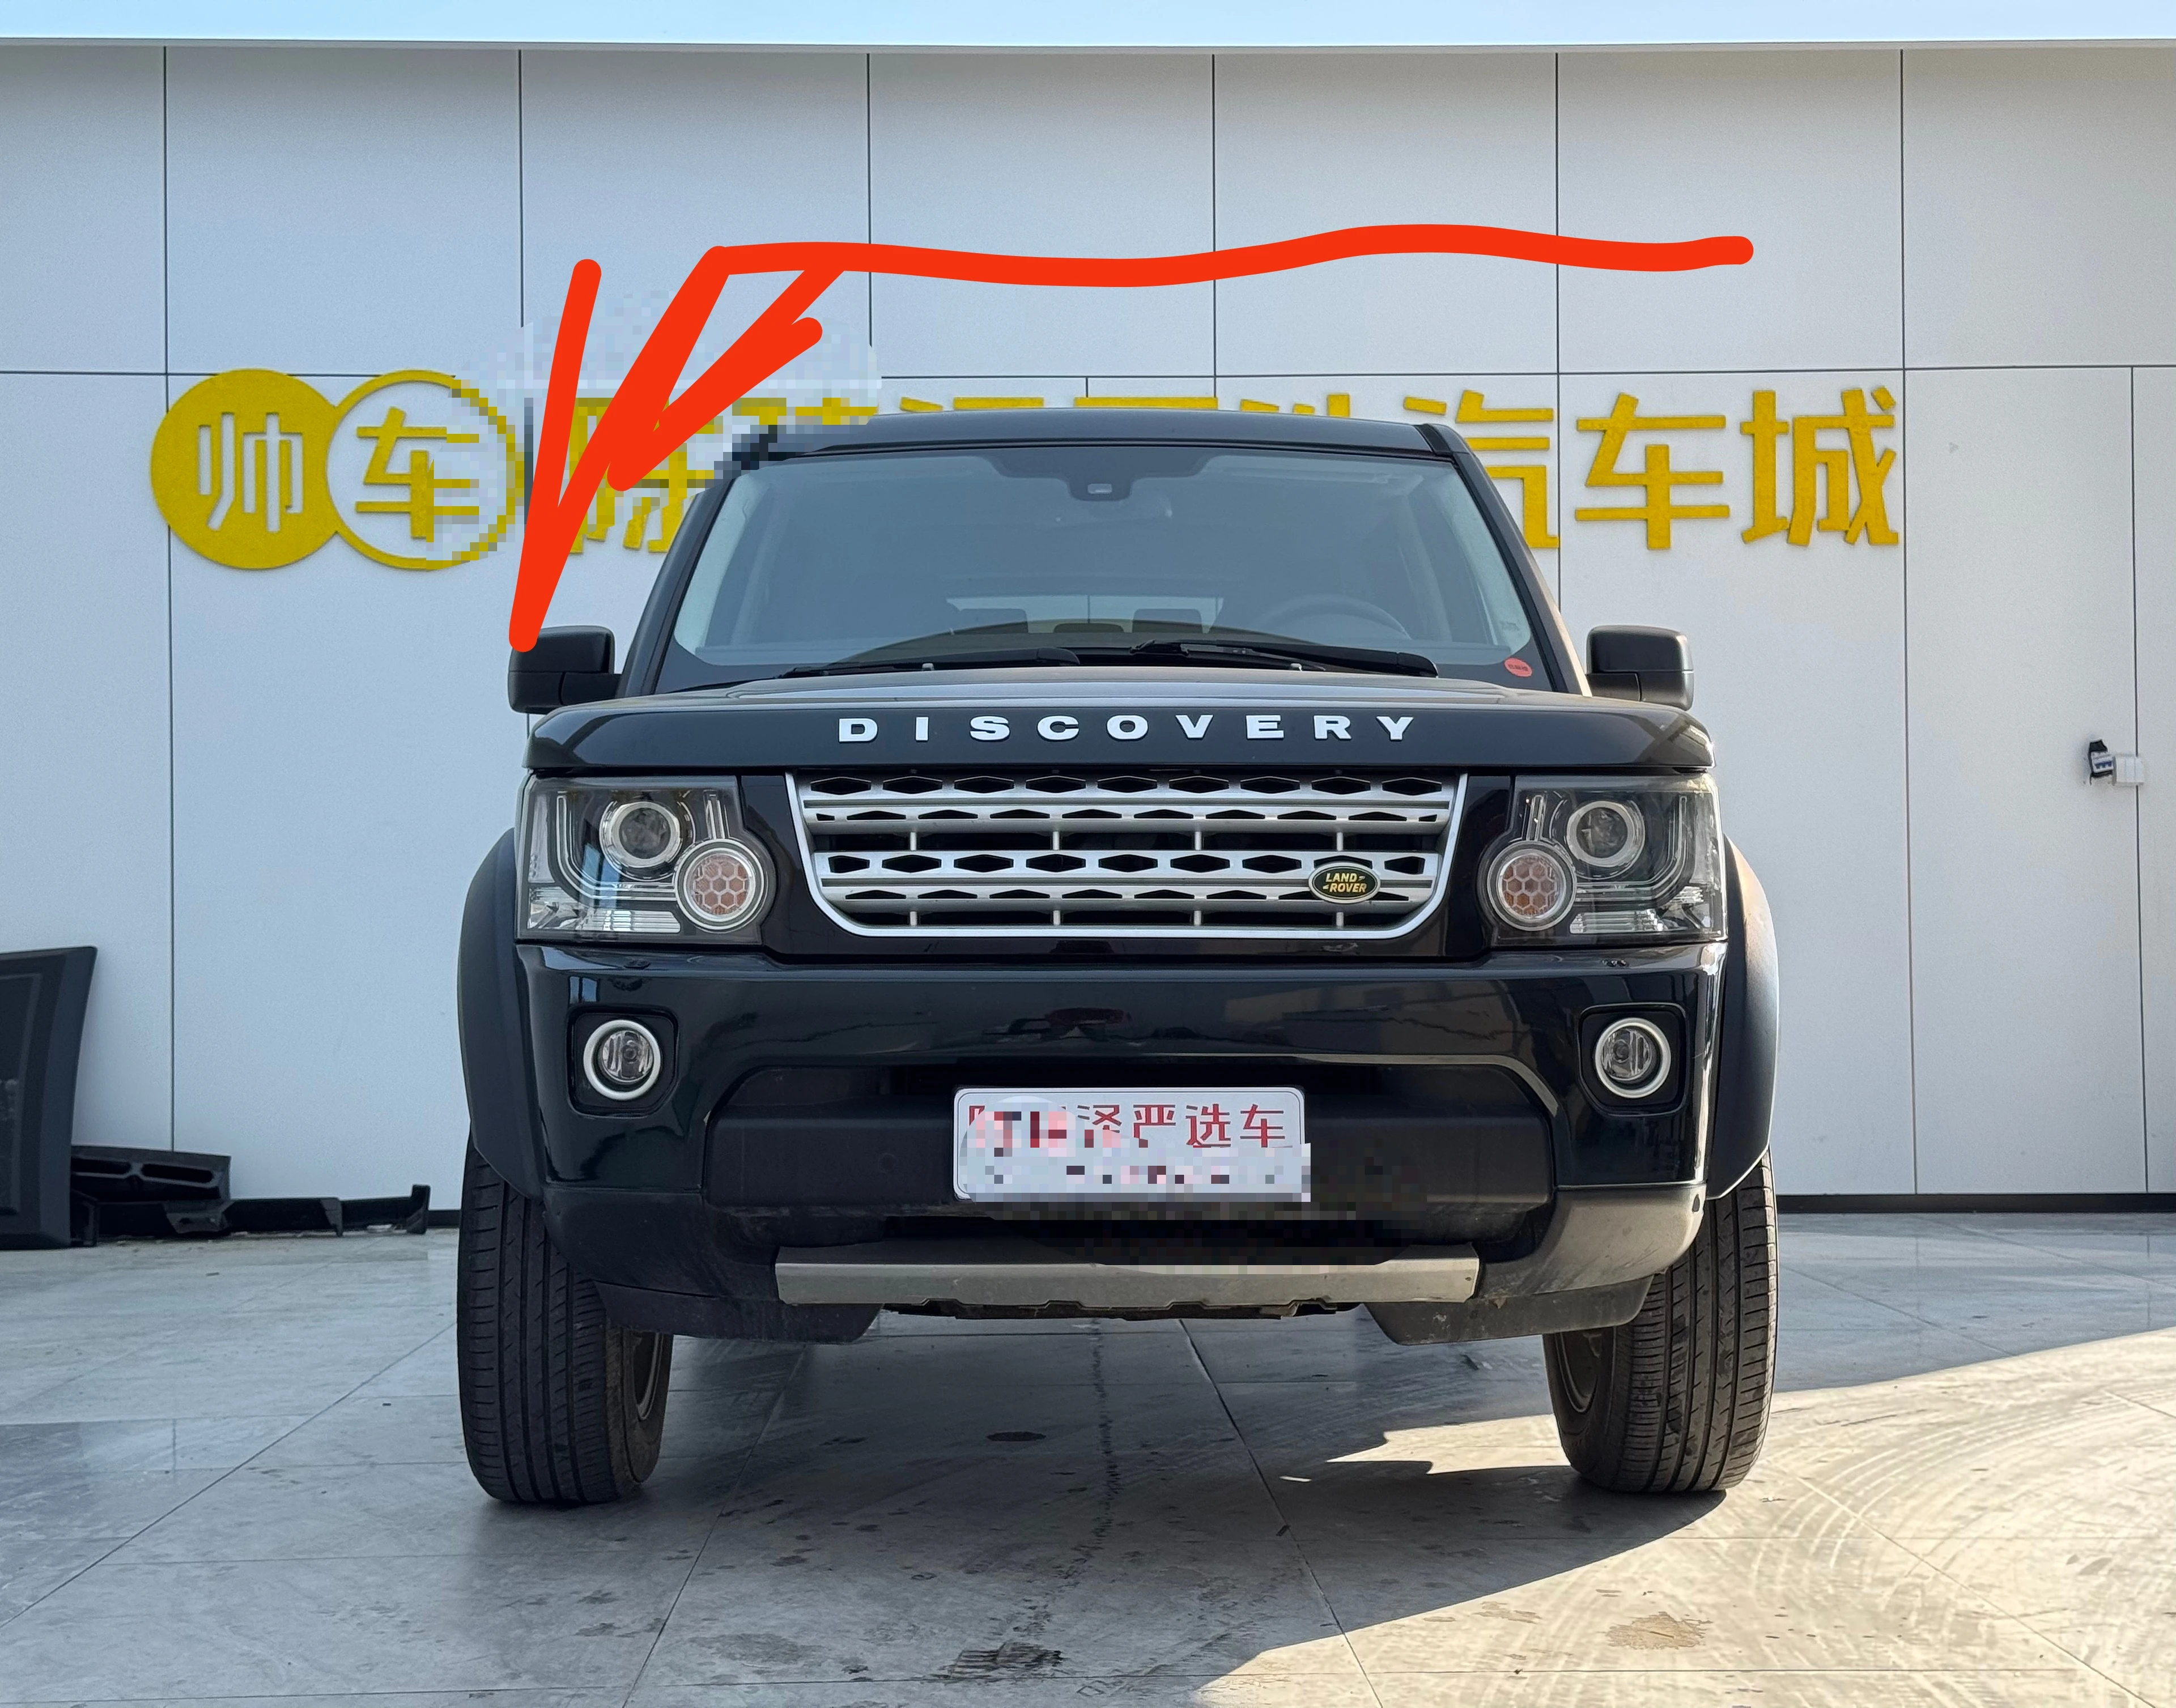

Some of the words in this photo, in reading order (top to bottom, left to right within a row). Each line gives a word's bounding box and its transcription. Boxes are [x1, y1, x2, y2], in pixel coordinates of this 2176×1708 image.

[838, 714, 1414, 743] DISCOVERY
[1325, 873, 1358, 882] LAND
[1329, 883, 1367, 892] ROVER
